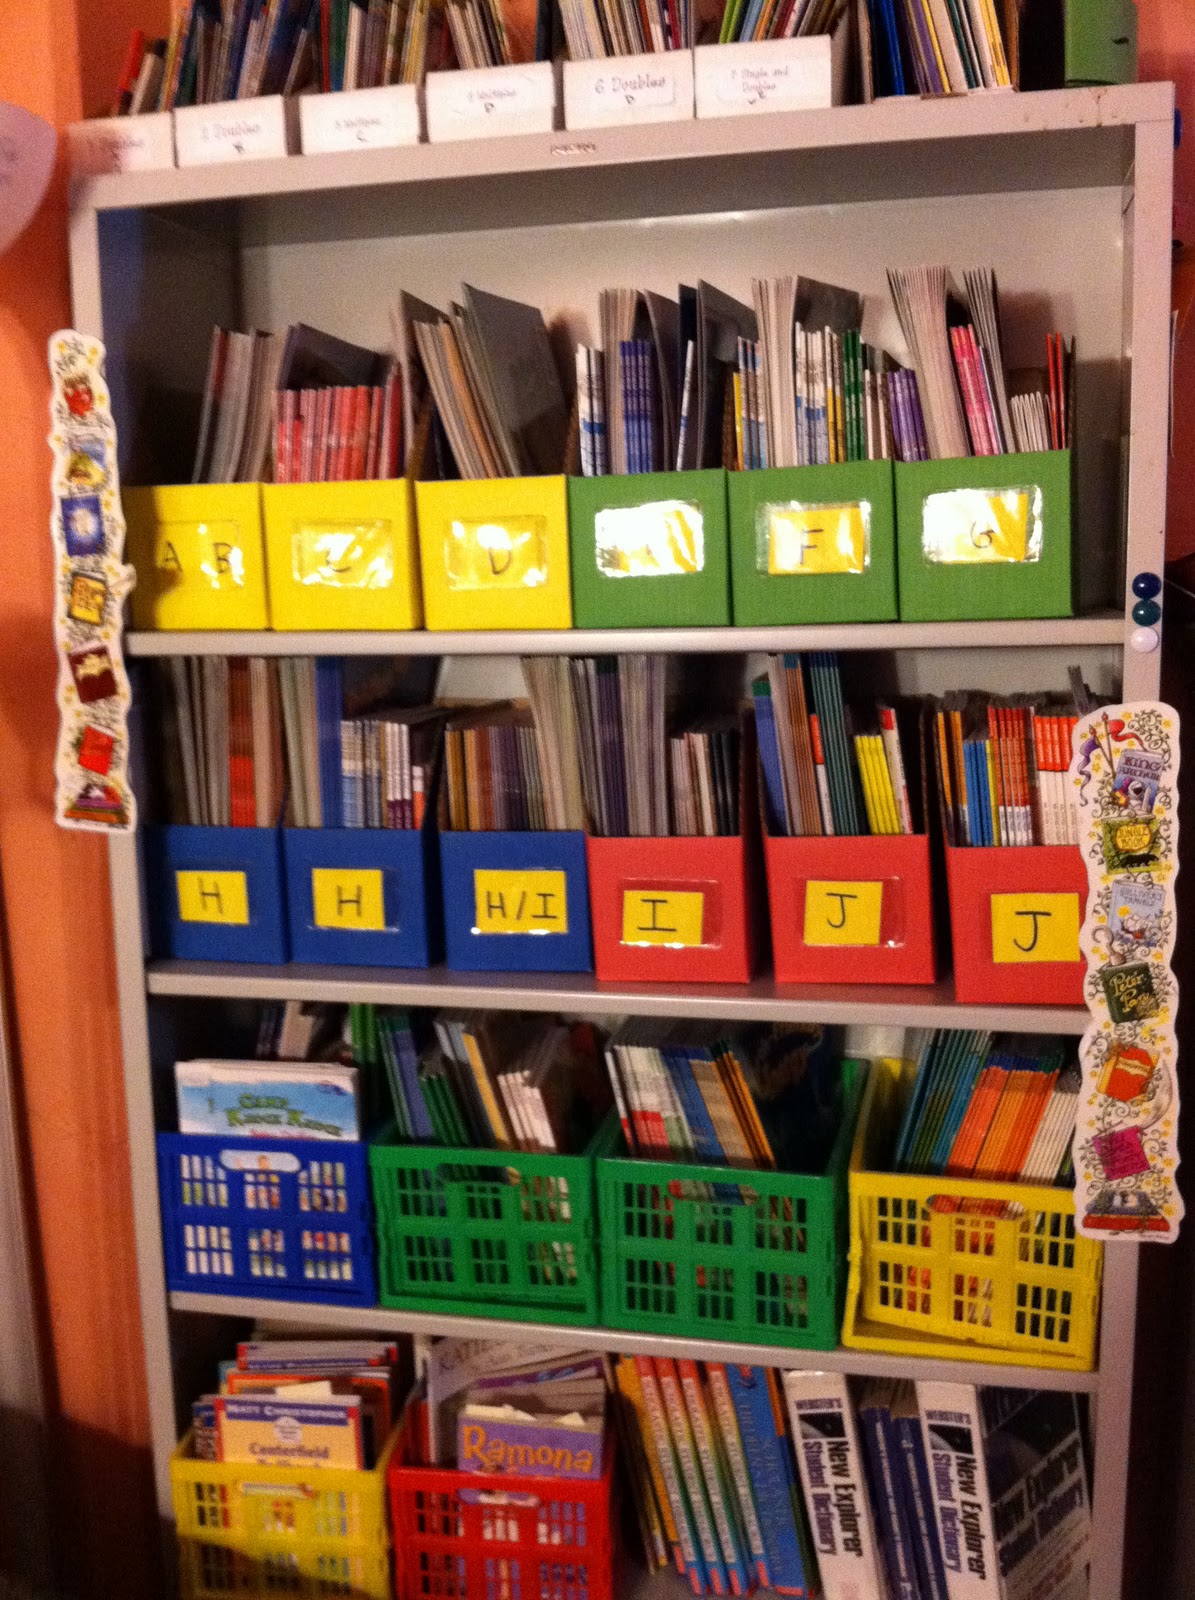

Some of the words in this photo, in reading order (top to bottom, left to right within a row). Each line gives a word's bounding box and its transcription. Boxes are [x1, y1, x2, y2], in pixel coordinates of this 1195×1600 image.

[594, 77, 605, 94] 6
[611, 73, 666, 93] Doubles
[213, 541, 235, 574] B
[800, 528, 824, 566] F
[197, 877, 224, 916] H
[336, 884, 364, 918] H
[637, 897, 678, 933] I
[825, 891, 859, 930] J
[1012, 910, 1053, 953] J
[462, 1425, 594, 1474] Ramona
[802, 1441, 829, 1489] Student
[827, 1440, 851, 1479] New
[931, 1452, 957, 1503] Student
[955, 1454, 977, 1496] New
[812, 1492, 838, 1556] Dictionary
[834, 1483, 864, 1558] Explorer
[939, 1505, 962, 1573] Dictionary
[959, 1499, 987, 1581] Explorer
